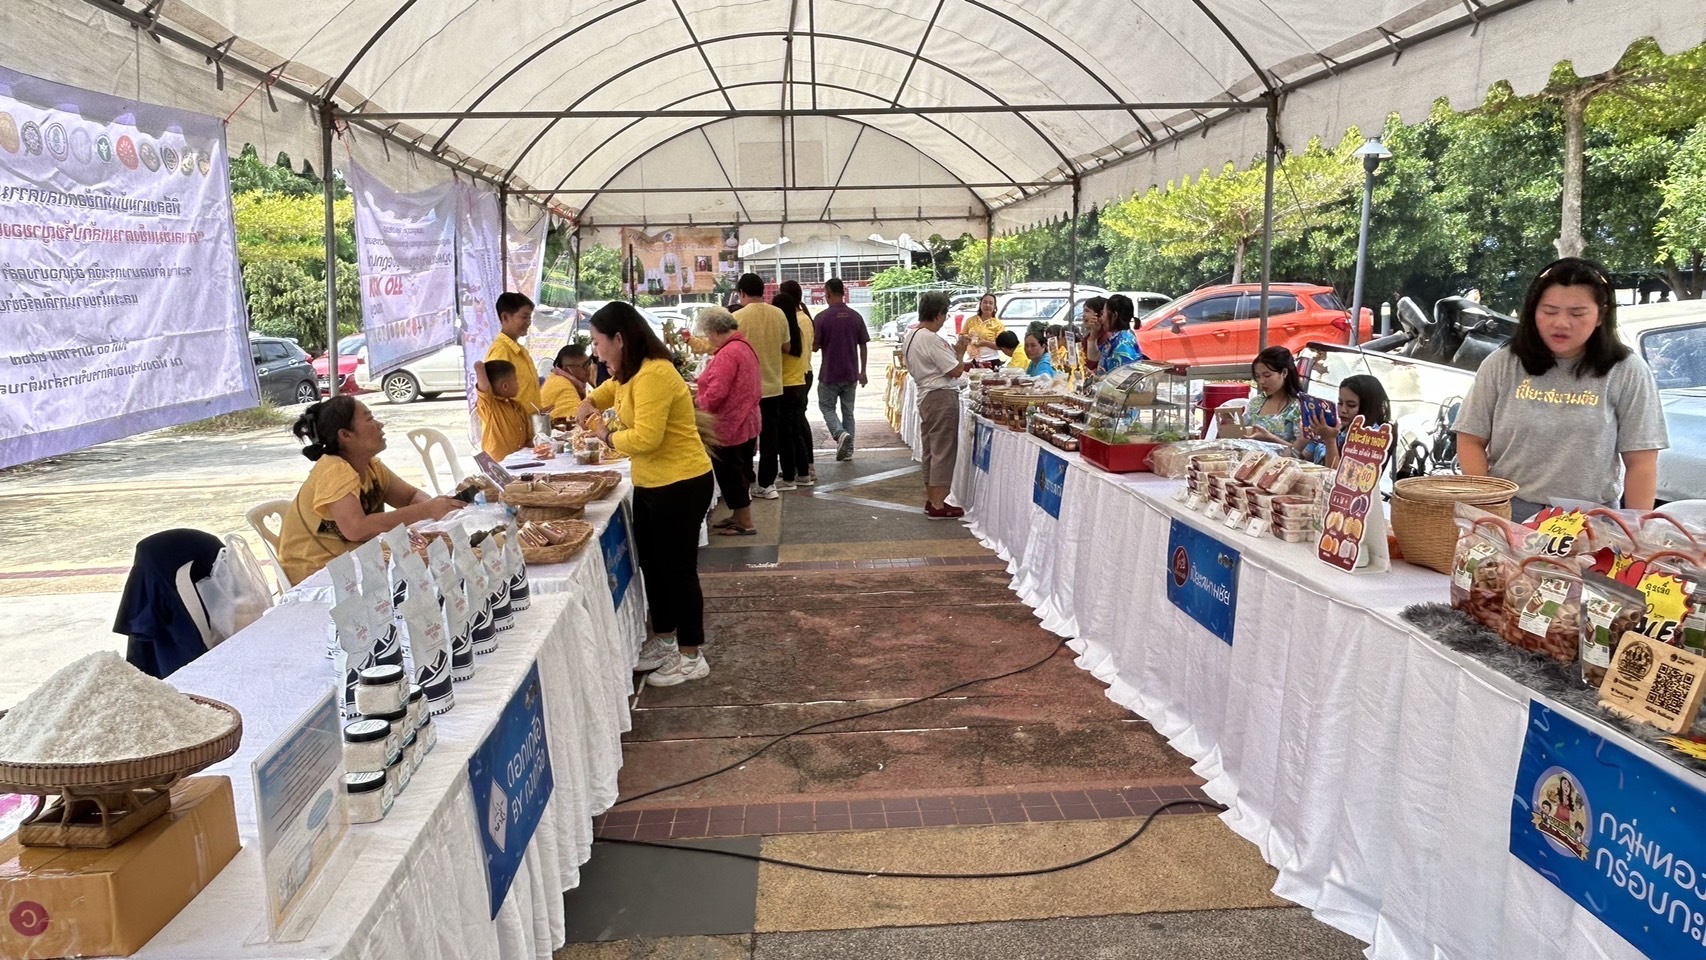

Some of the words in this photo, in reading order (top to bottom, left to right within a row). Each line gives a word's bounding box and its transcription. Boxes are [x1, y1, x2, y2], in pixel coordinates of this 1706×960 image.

[512, 789, 523, 824] BY
[1595, 847, 1706, 947] กรอบกะ
